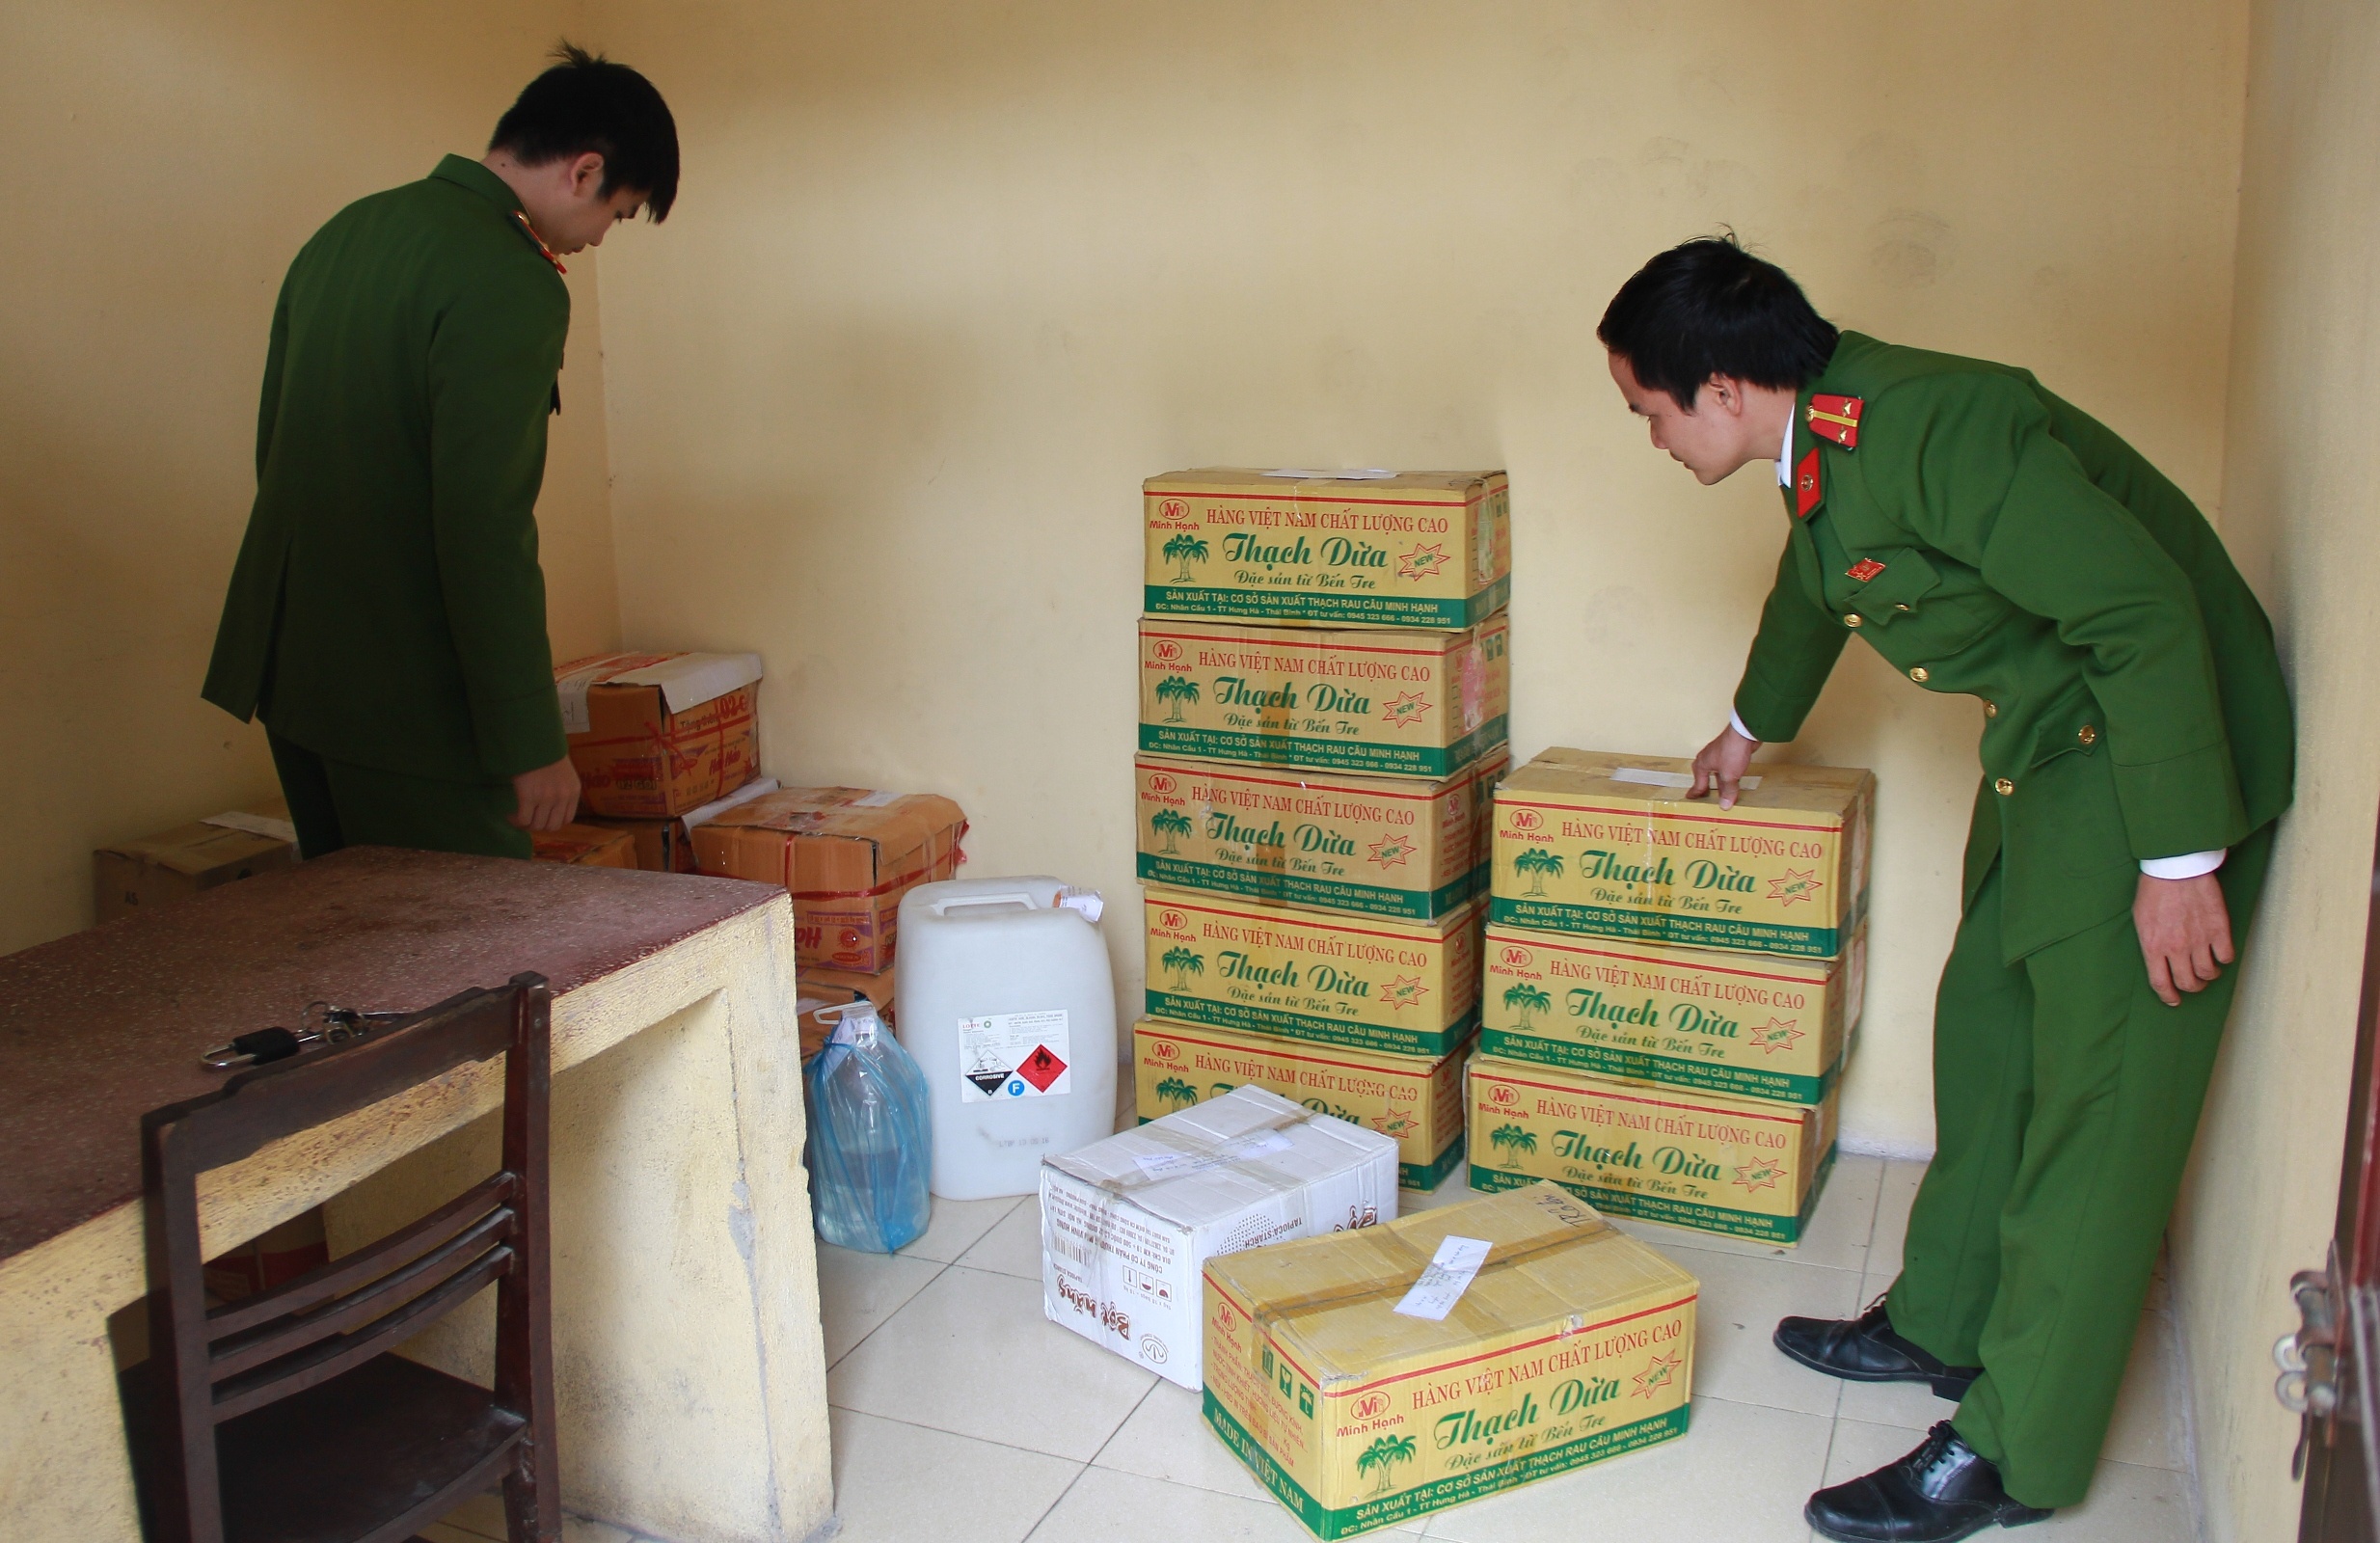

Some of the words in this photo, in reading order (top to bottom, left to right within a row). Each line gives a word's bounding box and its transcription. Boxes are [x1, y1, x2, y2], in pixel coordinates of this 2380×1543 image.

[1149, 520, 1172, 528] Minh
[1175, 521, 1199, 532] Hạnh
[1206, 504, 1244, 525] HÀNG
[1248, 506, 1281, 529] VIỆT
[1285, 511, 1316, 528] NAM
[1320, 507, 1359, 529] CHẤT
[1362, 513, 1413, 534] LƯỢNG
[1418, 517, 1448, 533] CAO
[1222, 532, 1310, 570] Thạch
[1320, 536, 1386, 567] Dừa
[1414, 552, 1434, 567] NEW
[1165, 588, 1184, 601] SẢN
[1185, 588, 1209, 602] XUẤT
[1211, 592, 1229, 605] TẠI:
[1231, 593, 1243, 604] CƠ
[1245, 590, 1258, 604] SỞ
[1259, 592, 1279, 605] SẢN
[1281, 592, 1305, 607] XUẤT
[1307, 597, 1339, 609] THẠCH
[1340, 599, 1361, 609] RAU
[1385, 601, 1408, 611] MINH
[1410, 602, 1438, 615] HẠNH
[1144, 661, 1165, 669] Minh
[1168, 662, 1191, 673] Hạnh
[1199, 647, 1235, 667] HÀNG
[1238, 650, 1270, 673] VIỆT
[1273, 657, 1303, 673] NAM
[1307, 654, 1344, 675] CHẤT
[1347, 661, 1396, 682] LƯỢNG
[1401, 664, 1430, 682] CAO
[1214, 676, 1296, 714] Thạch
[1307, 683, 1368, 714] Dừa
[1396, 701, 1415, 715] NEW
[1191, 782, 1227, 803] HÀNG
[1230, 788, 1259, 810] VIỆT
[1262, 795, 1291, 812] NAM
[1295, 795, 1331, 816] CHẤT
[1334, 802, 1381, 824] LƯỢNG
[1385, 808, 1414, 825] CAO
[1207, 811, 1284, 850] Thạch
[1293, 824, 1354, 855] Dừa
[1499, 829, 1524, 840] Minh
[1527, 832, 1554, 844] Hạnh
[1561, 818, 1603, 839] HÀNG
[1608, 822, 1642, 846] VIỆT
[1649, 829, 1680, 847] NAM
[1684, 827, 1726, 851] CHẤT
[1729, 835, 1784, 858] LƯỢNG
[1789, 841, 1823, 858] CAO
[1381, 846, 1399, 858] NEW
[1582, 850, 1673, 889] Thạch
[1685, 859, 1754, 892] Dừa
[1149, 928, 1171, 938] Minh
[1173, 932, 1196, 942] Hạnh
[1203, 920, 1238, 941] HÀNG
[1241, 926, 1272, 948] VIỆT
[1275, 933, 1304, 951] NAM
[1308, 934, 1343, 956] CHẤT
[1347, 943, 1393, 963] LƯỢNG
[1398, 950, 1427, 967] CAO
[1218, 950, 1297, 988] Thạch
[1307, 964, 1368, 996] Dừa
[1489, 965, 1513, 975] Minh
[1516, 968, 1542, 981] Hạnh
[1550, 958, 1590, 979] HÀNG
[1595, 964, 1629, 988] VIỆT
[1632, 971, 1665, 990] NAM
[1669, 974, 1711, 996] CHẤT
[1714, 983, 1768, 1005] LƯỢNG
[1771, 990, 1804, 1009] CAO
[1395, 985, 1414, 1000] NEW
[1569, 988, 1658, 1029] Thạch
[1668, 1003, 1738, 1038] Dừa
[975, 1072, 1005, 1081] CORROSIVE
[1012, 1083, 1020, 1094] F
[1195, 1051, 1230, 1072] HÀNG
[1233, 1059, 1262, 1079] VIỆT
[1266, 1066, 1295, 1083] NAM
[1299, 1069, 1335, 1089] CHẤT
[1388, 1084, 1418, 1101] CAO
[1386, 1120, 1405, 1131] NEW
[1536, 1096, 1576, 1119] HÀNG
[1581, 1103, 1614, 1126] VIỆT
[1616, 1111, 1650, 1130] NAM
[1654, 1114, 1694, 1136] CHẤT
[1697, 1123, 1749, 1145] LƯỢNG
[1754, 1130, 1786, 1149] CAO
[1555, 1129, 1641, 1170] Thạch
[1652, 1146, 1719, 1180] Dừa
[1244, 1231, 1272, 1248] STARCH
[1275, 1216, 1302, 1236] TAPIOCA
[1101, 1301, 1131, 1341] Bột
[1412, 1381, 1460, 1409] HÀNG
[1465, 1367, 1503, 1394] VIỆT
[1507, 1358, 1543, 1384] NAM
[1548, 1340, 1590, 1372] CHẤT
[1594, 1329, 1647, 1360] LƯỢNG
[1652, 1319, 1682, 1342] CAO
[1647, 1365, 1667, 1385] NEW
[1338, 1422, 1367, 1437] Minh
[1371, 1413, 1402, 1429] Hạnh
[1437, 1393, 1537, 1447] Thạch
[1549, 1376, 1619, 1415] Dừa
[1213, 1407, 1240, 1444] MADE
[1240, 1437, 1253, 1460] IN
[1254, 1451, 1278, 1487] VIỆT
[1279, 1476, 1305, 1514] NAM
